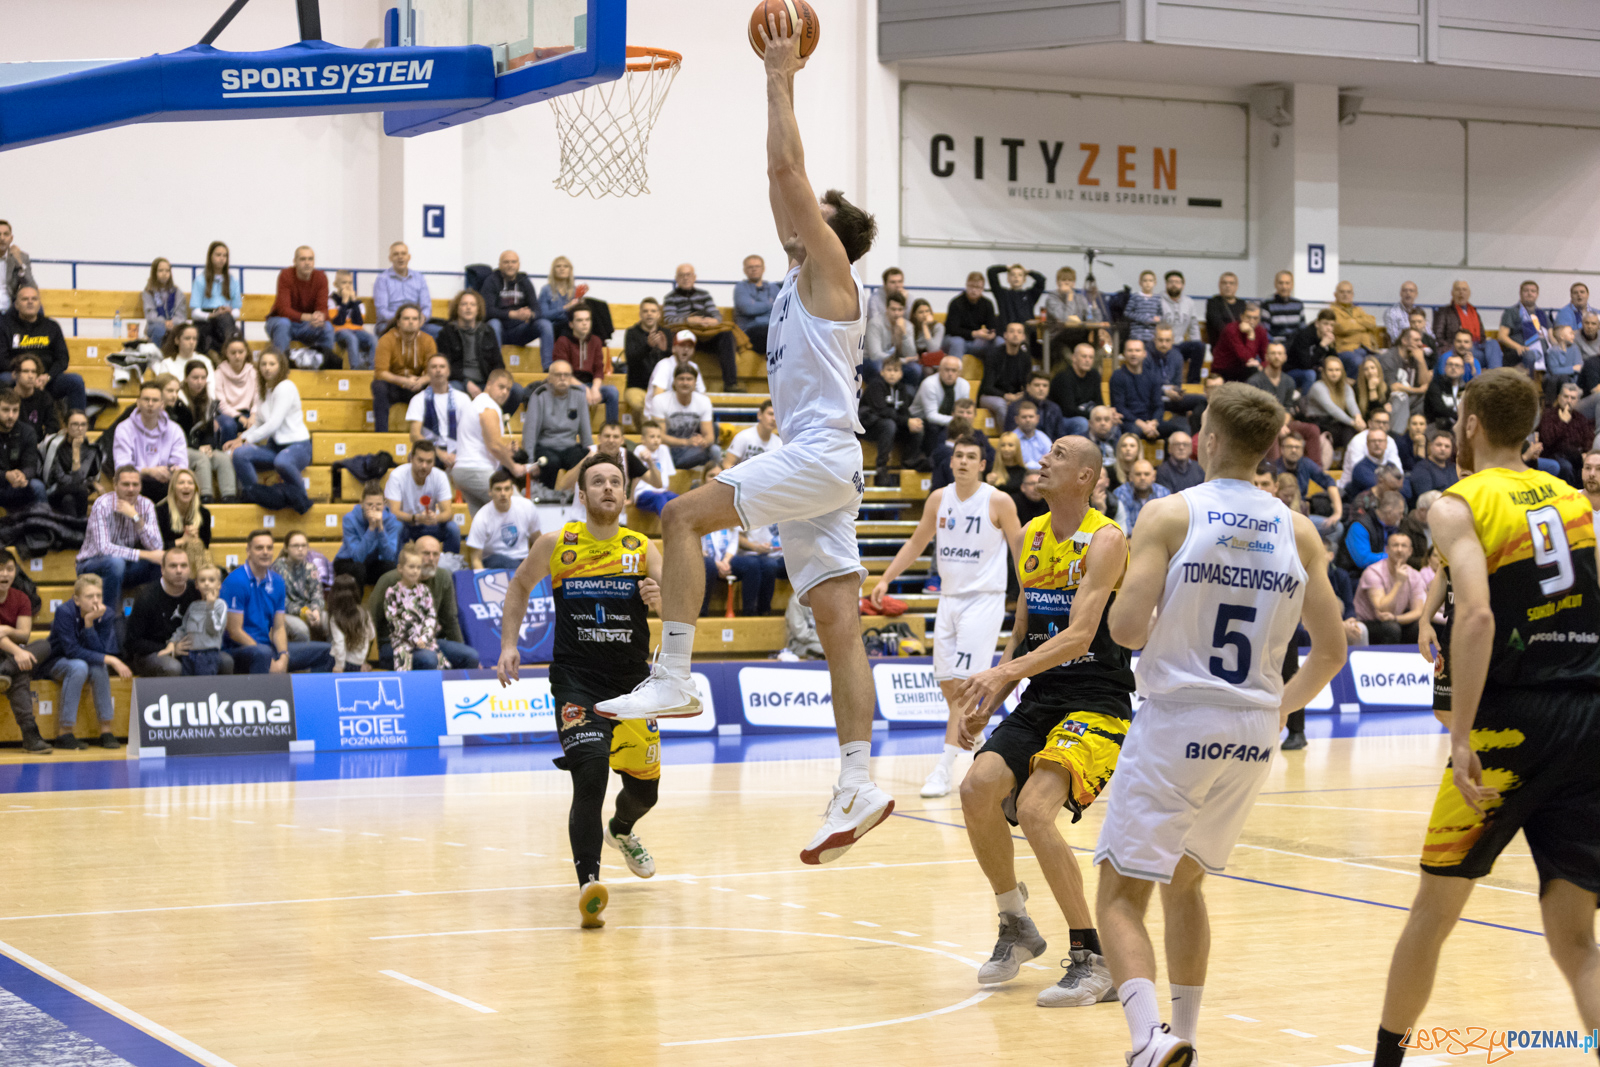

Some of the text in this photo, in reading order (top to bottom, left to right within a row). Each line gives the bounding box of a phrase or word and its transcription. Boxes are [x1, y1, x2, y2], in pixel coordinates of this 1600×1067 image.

[221, 59, 435, 92] SPORT SYSTEM
[929, 133, 1178, 191] CITYZEN
[1080, 191, 1110, 203] KLUB
[1115, 192, 1178, 206] SPORTOWY
[427, 209, 441, 233] C
[1310, 248, 1322, 270] B
[965, 516, 981, 534] 71
[1231, 536, 1275, 551] funclub
[1526, 505, 1575, 597] 9
[621, 553, 640, 573] 91
[468, 596, 556, 620] BAKET
[1209, 602, 1257, 684] 5
[955, 651, 972, 670] 71
[1360, 672, 1430, 687] BIOFARM
[143, 692, 290, 728] drukma
[148, 723, 291, 741] DRUKARNIA SKOCZYŃSKI
[339, 716, 406, 736] HOTEL
[340, 734, 408, 747] POZNAŃSKI
[1185, 742, 1274, 763] BIOFARM
